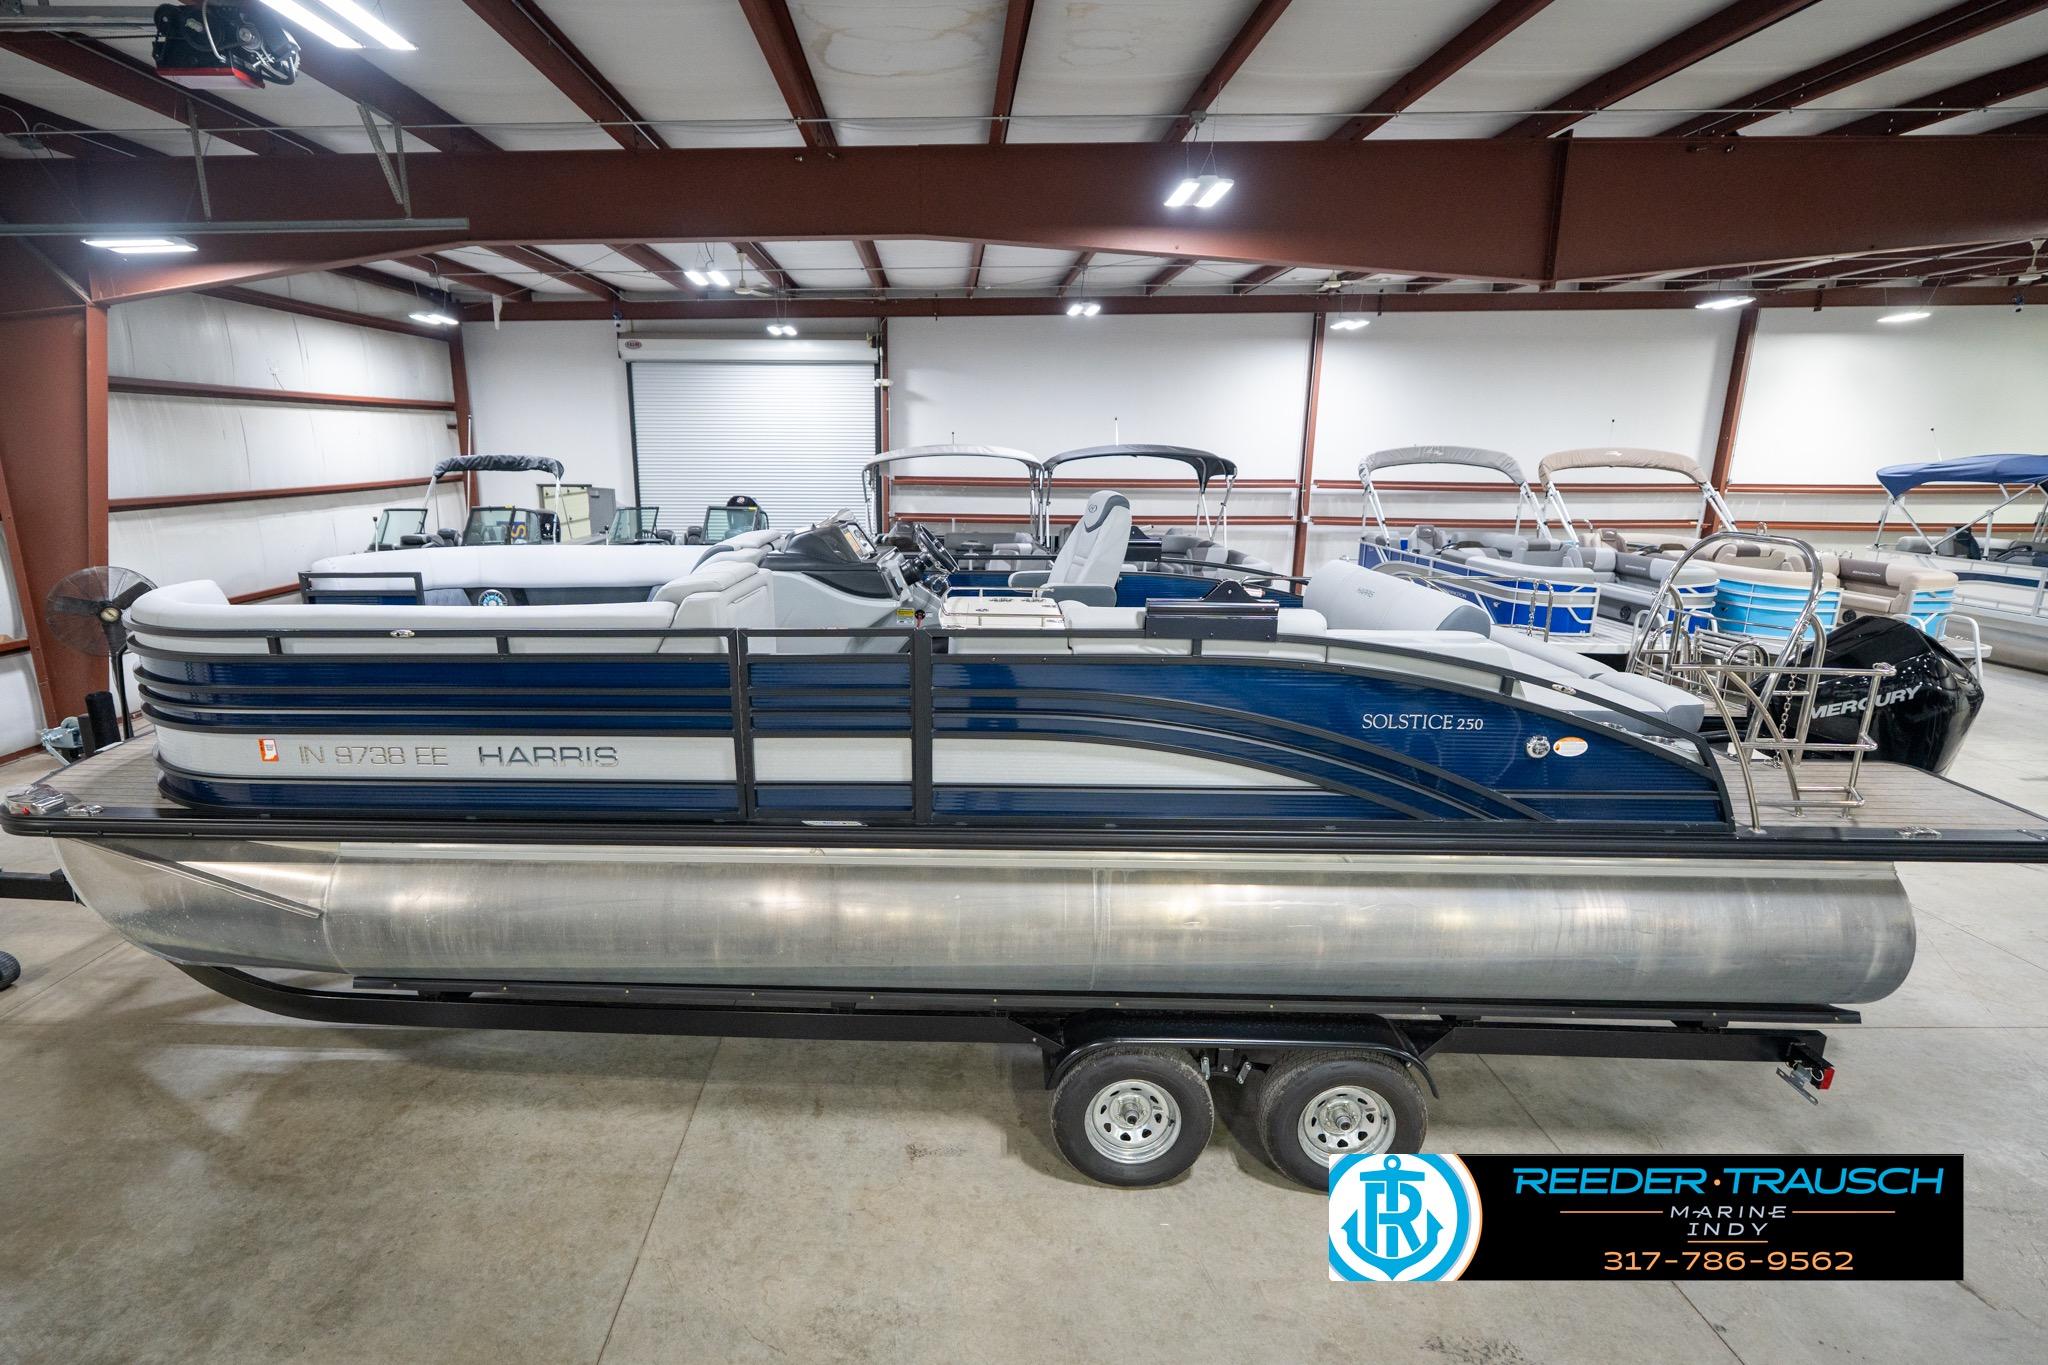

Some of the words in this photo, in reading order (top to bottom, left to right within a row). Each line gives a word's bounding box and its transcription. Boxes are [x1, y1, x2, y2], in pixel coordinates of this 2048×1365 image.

[1810, 684, 1922, 719] MERCURY
[1361, 713, 1454, 730] SOLSTICE
[1456, 718, 1484, 731] 250
[299, 745, 325, 764] IN
[335, 746, 406, 765] 9738
[415, 746, 449, 766] EE
[478, 746, 619, 768] HARRIS
